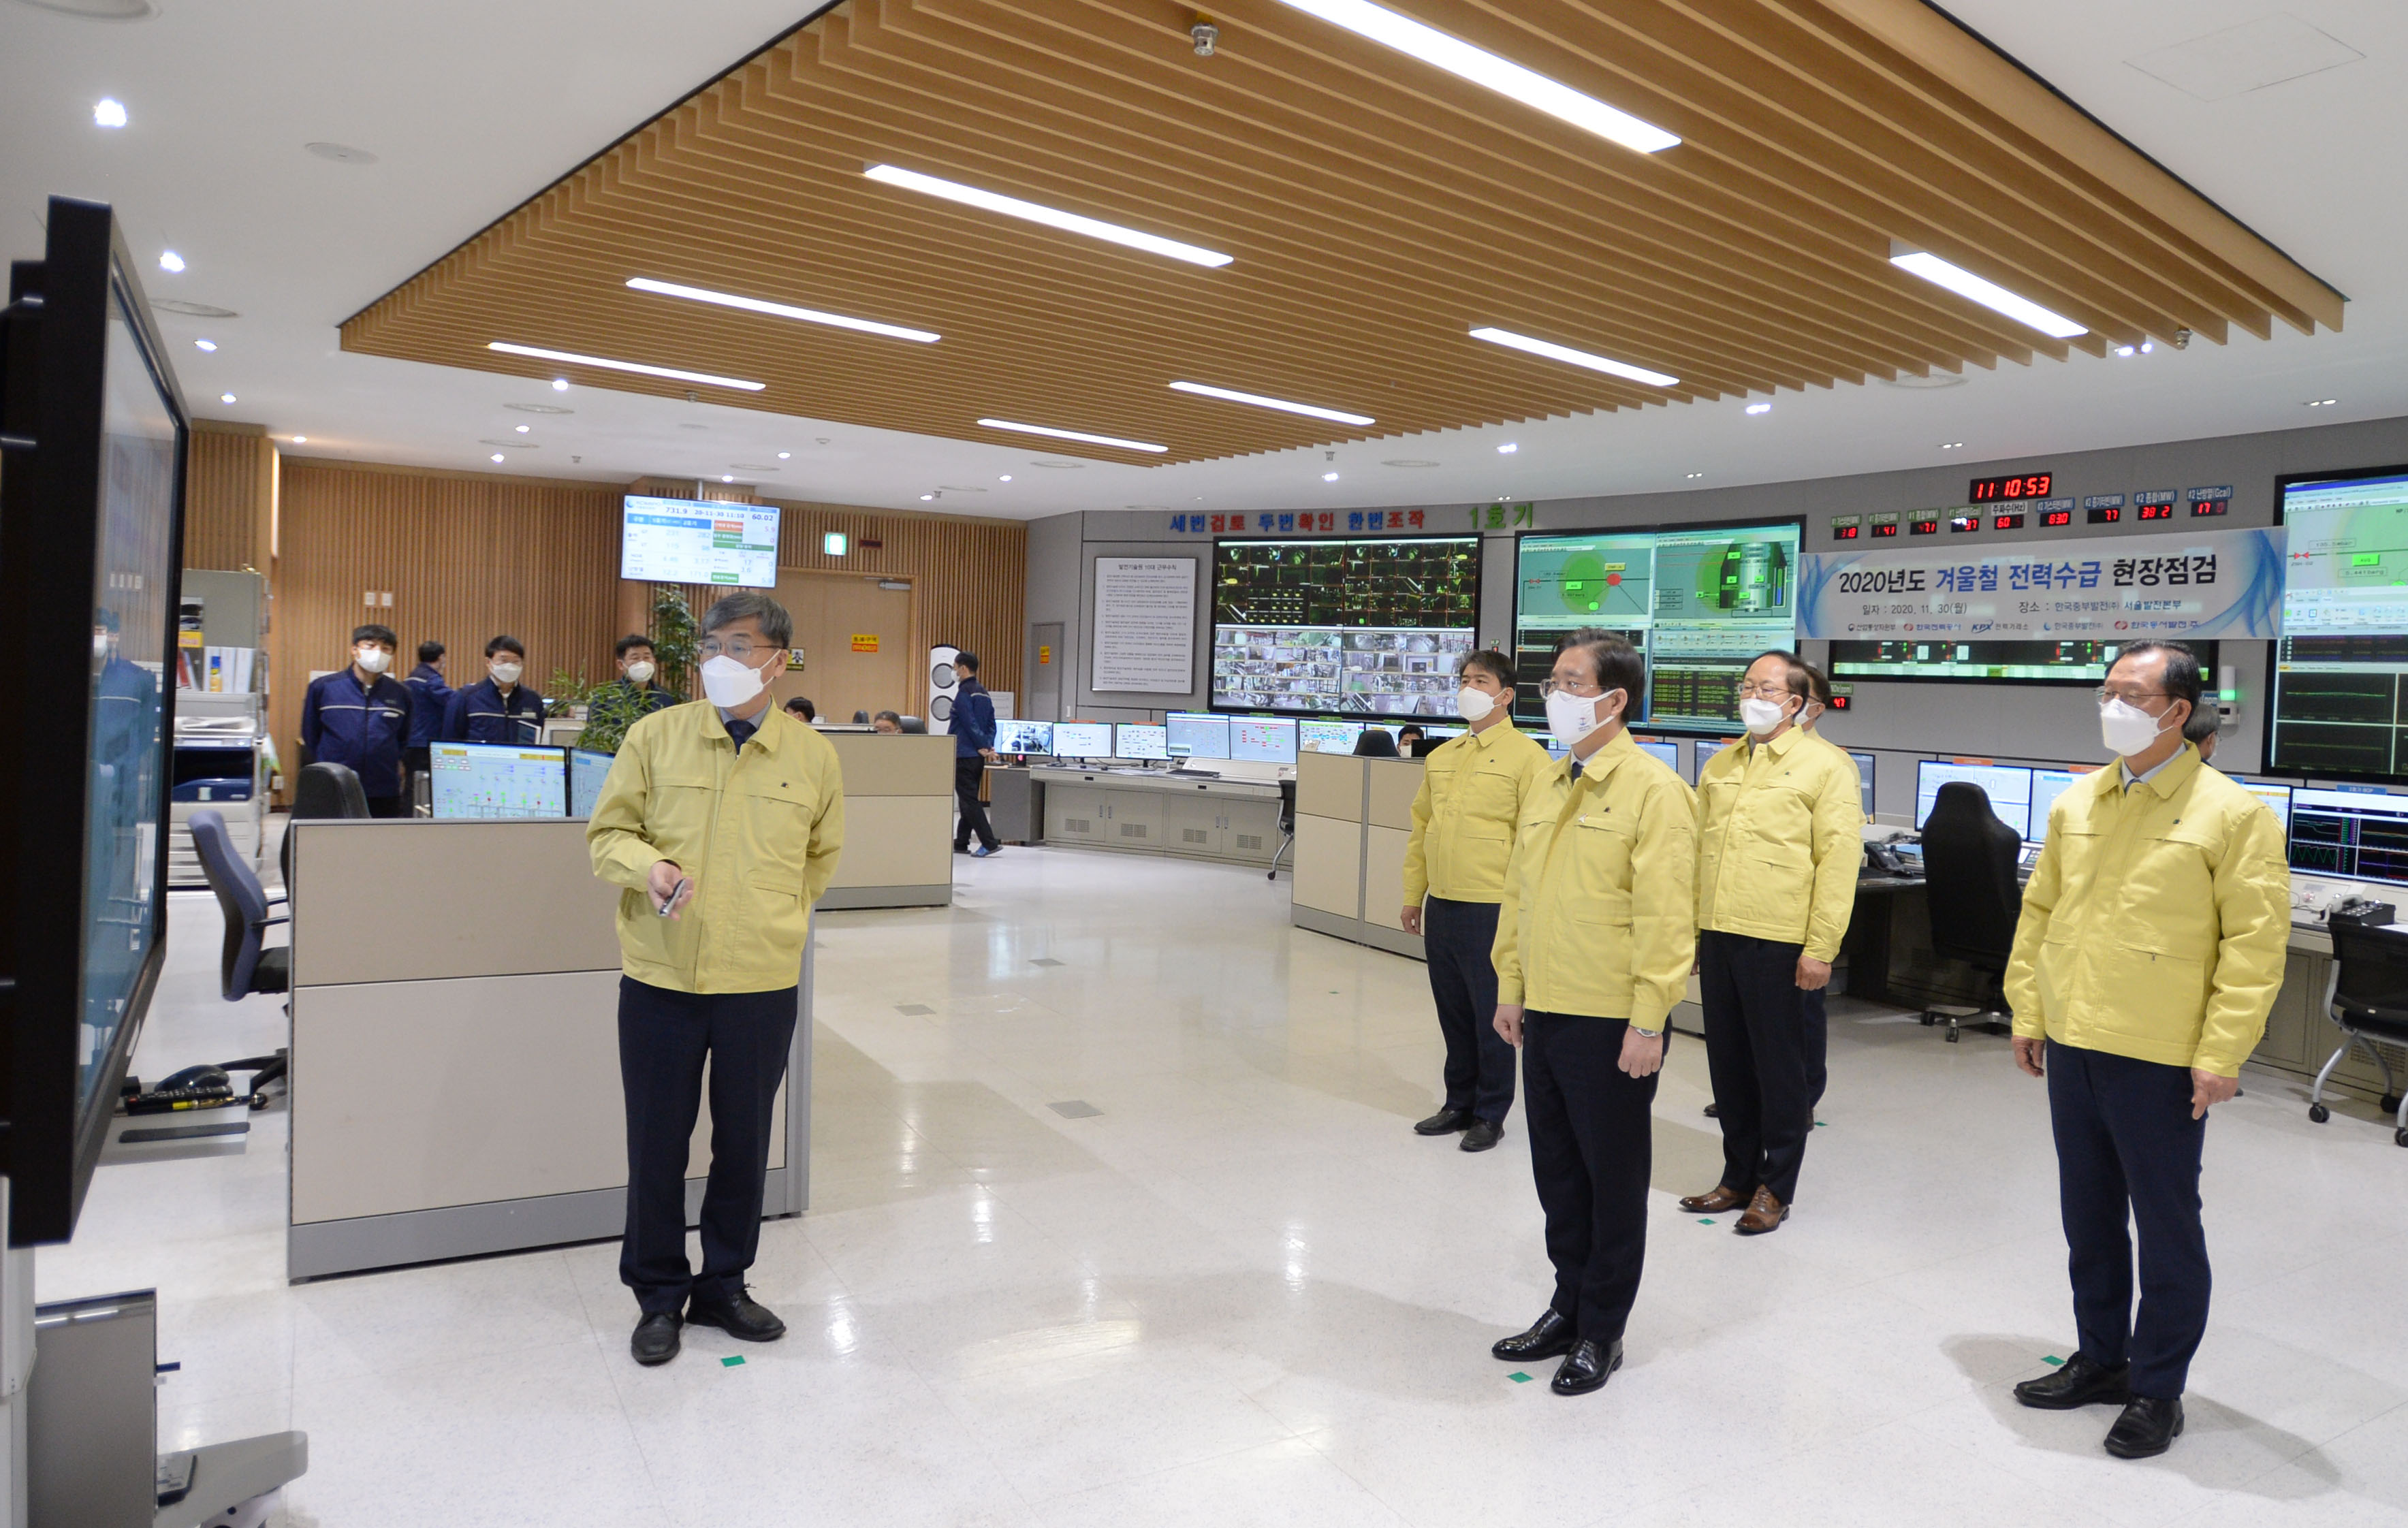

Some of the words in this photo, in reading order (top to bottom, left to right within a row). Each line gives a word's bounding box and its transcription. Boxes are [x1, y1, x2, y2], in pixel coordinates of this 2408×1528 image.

[2136, 493, 2144, 503] #2
[1993, 503, 2026, 514] 주파수(Hz)
[1470, 503, 1532, 529] 1호기
[1839, 569, 1925, 593] 2020년도
[1935, 564, 1999, 592] 겨울철
[2009, 560, 2102, 590] 전력수급
[2113, 554, 2217, 587] 현장점검
[1863, 604, 1880, 615] 일자
[1937, 602, 1967, 615] 30(월)
[2019, 601, 2040, 614] 장소
[2125, 600, 2183, 611] 서울발전본부
[1916, 623, 1961, 631] 한국전력공사
[1971, 620, 1993, 633] KPX
